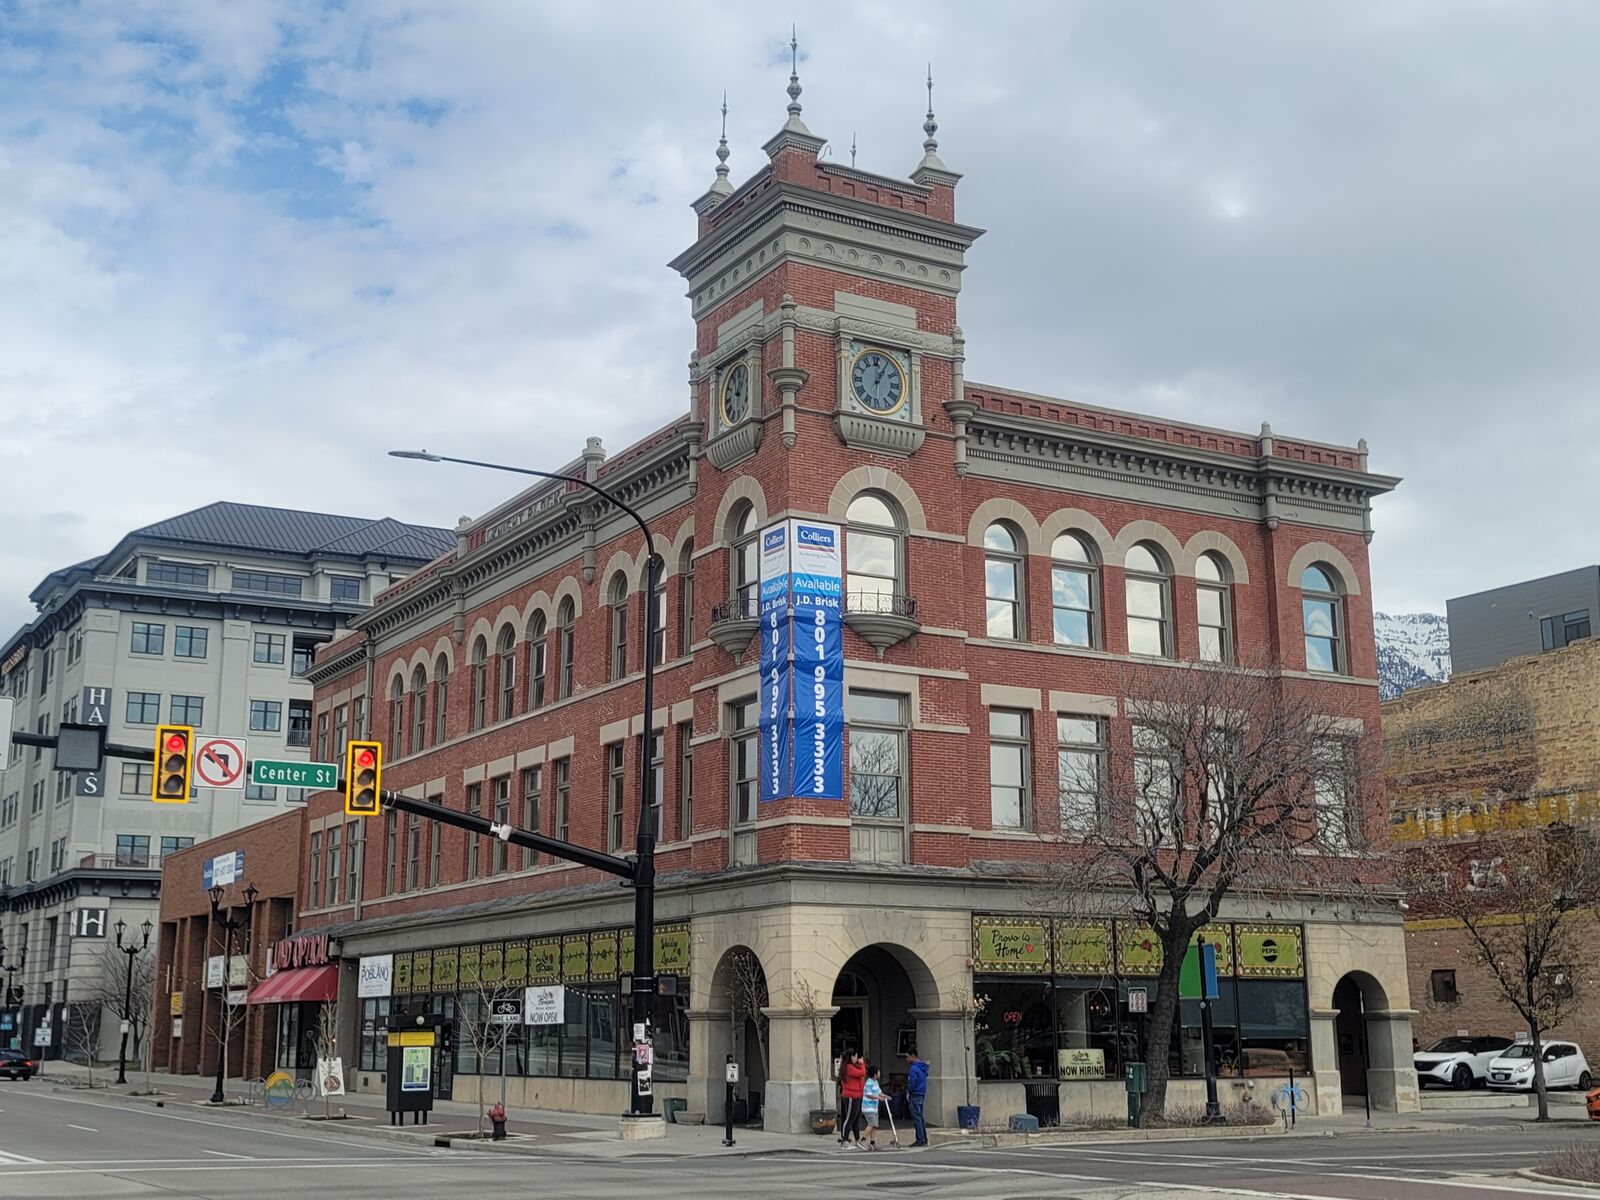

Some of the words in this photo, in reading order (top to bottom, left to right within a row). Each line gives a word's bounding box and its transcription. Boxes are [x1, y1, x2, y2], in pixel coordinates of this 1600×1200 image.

[766, 533, 784, 547] Colliers
[800, 530, 831, 543] Colliers
[762, 579, 788, 596] Available
[795, 577, 840, 591] Available
[772, 597, 787, 609] Brisk
[796, 595, 812, 605] J.D.
[815, 597, 839, 608] Brisk
[260, 765, 307, 782] Center
[316, 769, 331, 784] St
[80, 909, 105, 936] H
[991, 929, 1020, 943] Provo
[1022, 931, 1030, 942] is
[994, 942, 1025, 959] Home
[529, 1012, 544, 1023] NOW
[1004, 1011, 1022, 1022] OPEN
[1060, 1065, 1077, 1076] NOW
[1080, 1065, 1104, 1076] HIRING
